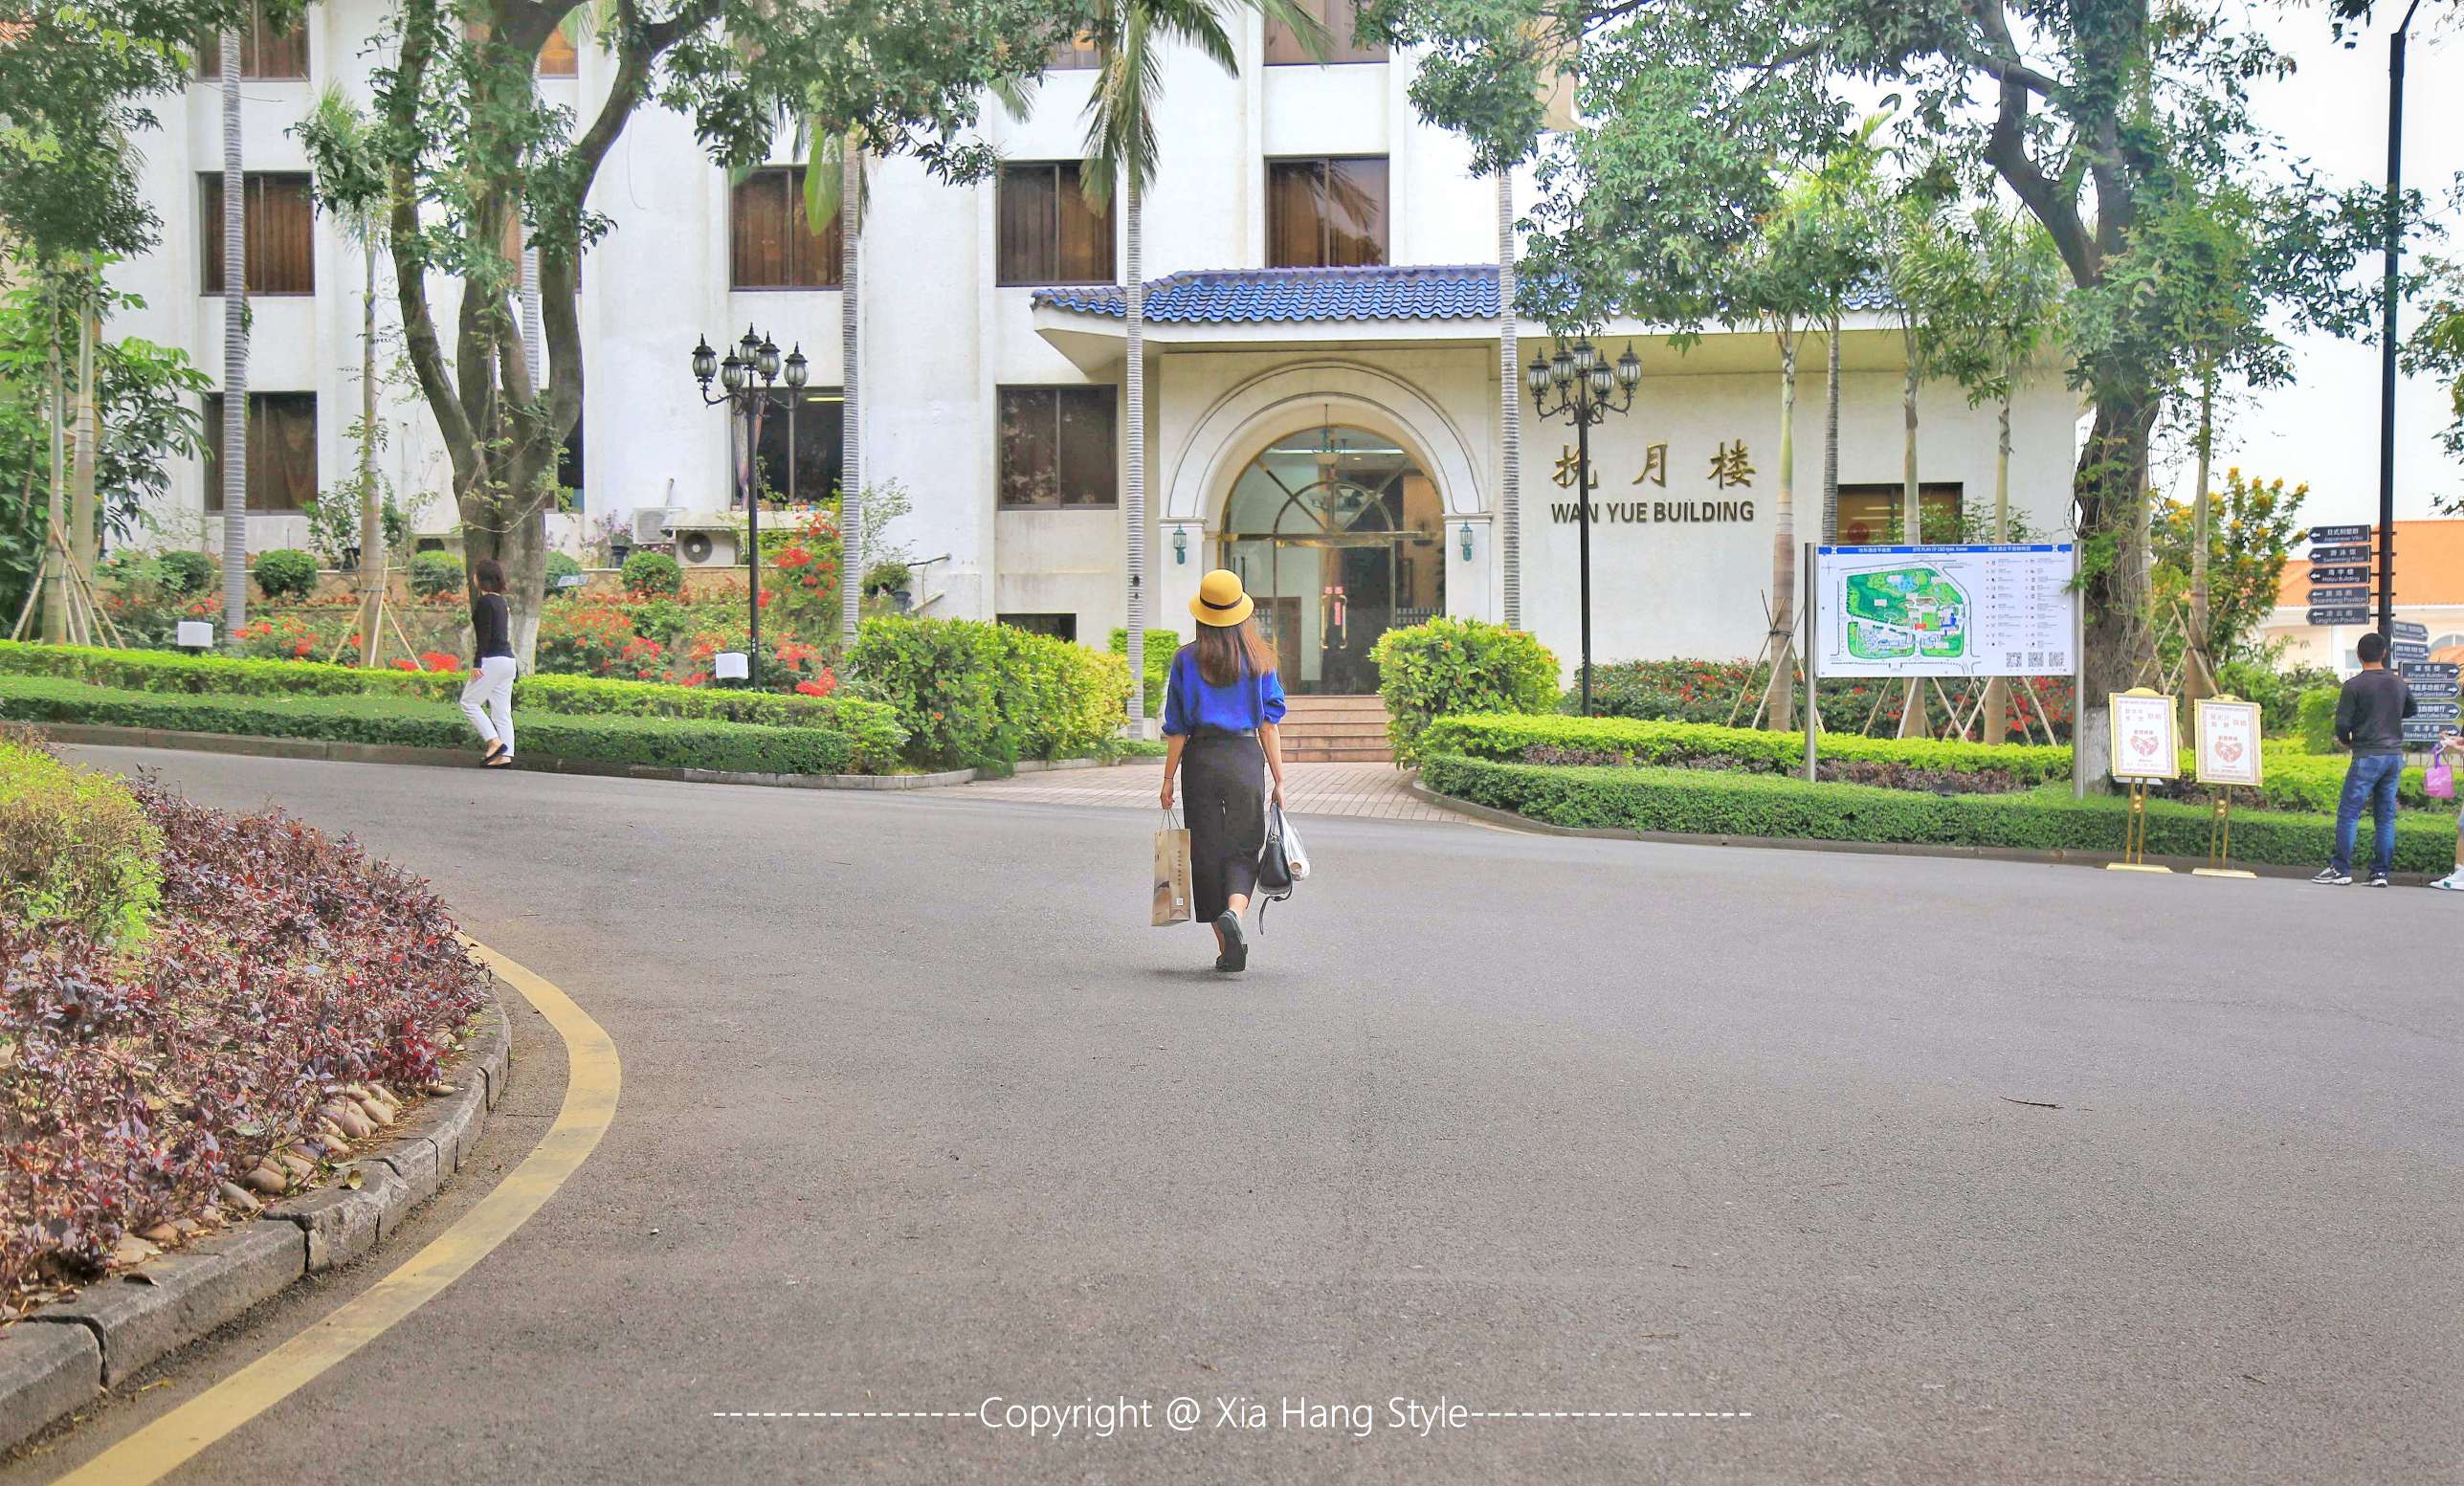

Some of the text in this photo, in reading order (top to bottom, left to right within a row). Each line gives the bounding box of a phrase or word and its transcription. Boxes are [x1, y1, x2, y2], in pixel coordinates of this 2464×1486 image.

[1551, 438, 1757, 490] 挽月楼
[1551, 499, 1755, 523] WAN YUE BUILDING
